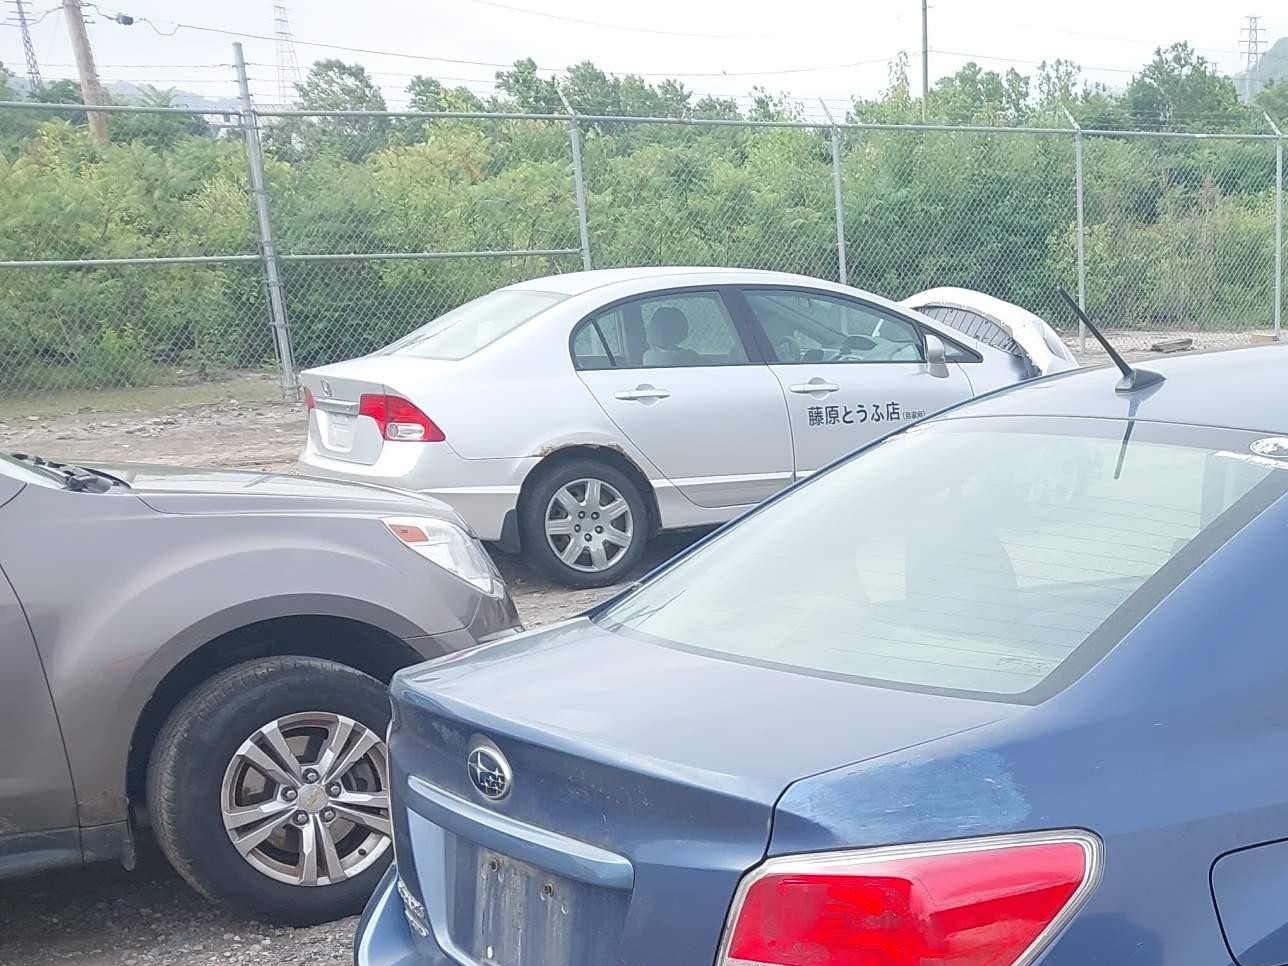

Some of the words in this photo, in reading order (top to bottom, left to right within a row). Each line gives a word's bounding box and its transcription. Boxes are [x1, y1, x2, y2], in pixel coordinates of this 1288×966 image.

[807, 402, 900, 426] 藤原とうふ店
